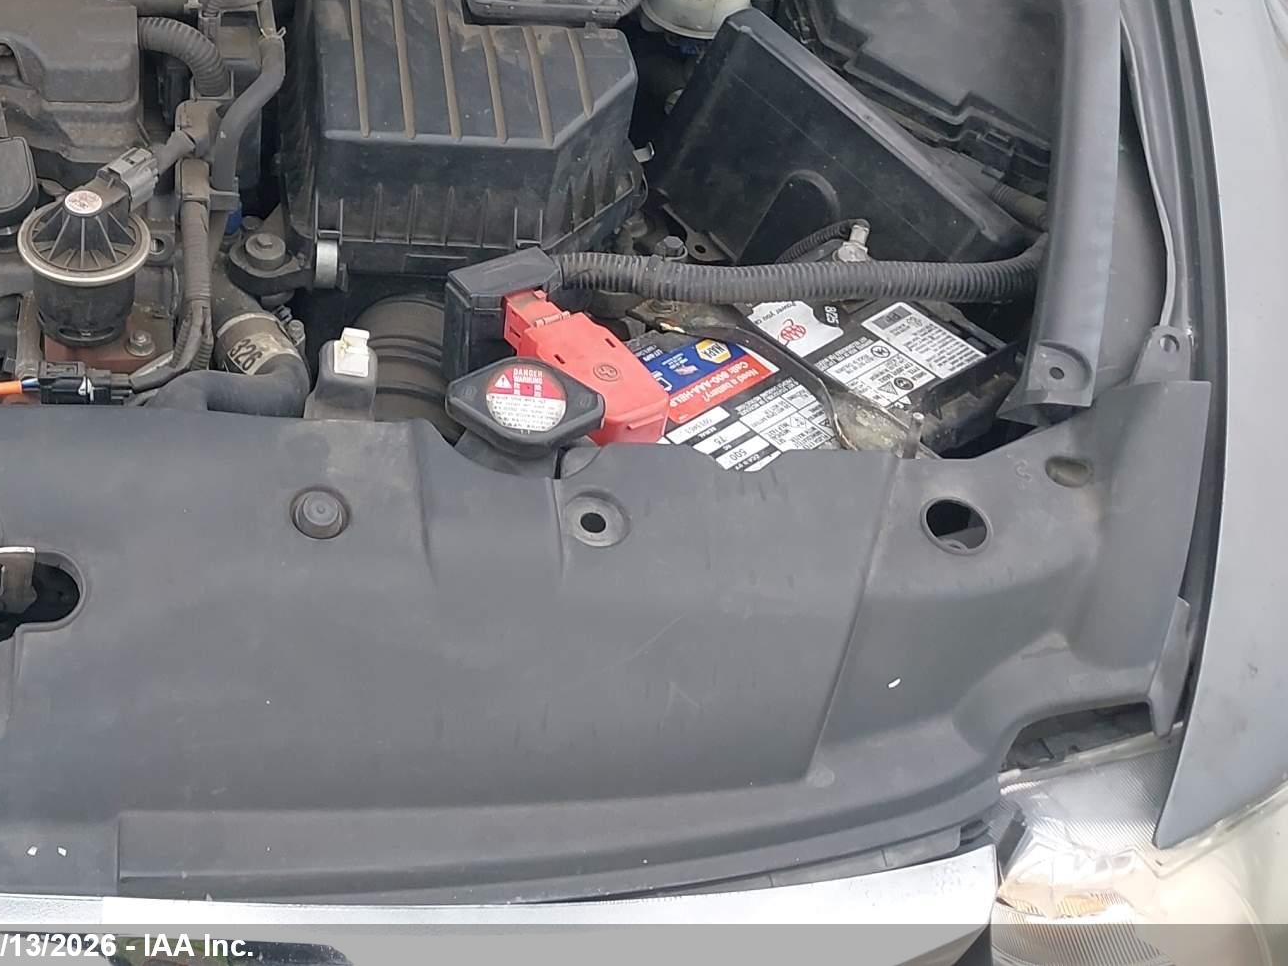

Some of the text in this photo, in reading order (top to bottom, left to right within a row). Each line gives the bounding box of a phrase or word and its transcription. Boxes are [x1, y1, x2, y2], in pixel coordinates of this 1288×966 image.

[229, 338, 263, 371] 326
[700, 342, 724, 358] NAPA
[737, 368, 760, 383] Need
[669, 370, 730, 407] 800-AAA-HELP
[701, 381, 733, 403] battery?
[713, 436, 726, 445] 75
[729, 448, 748, 461] 500
